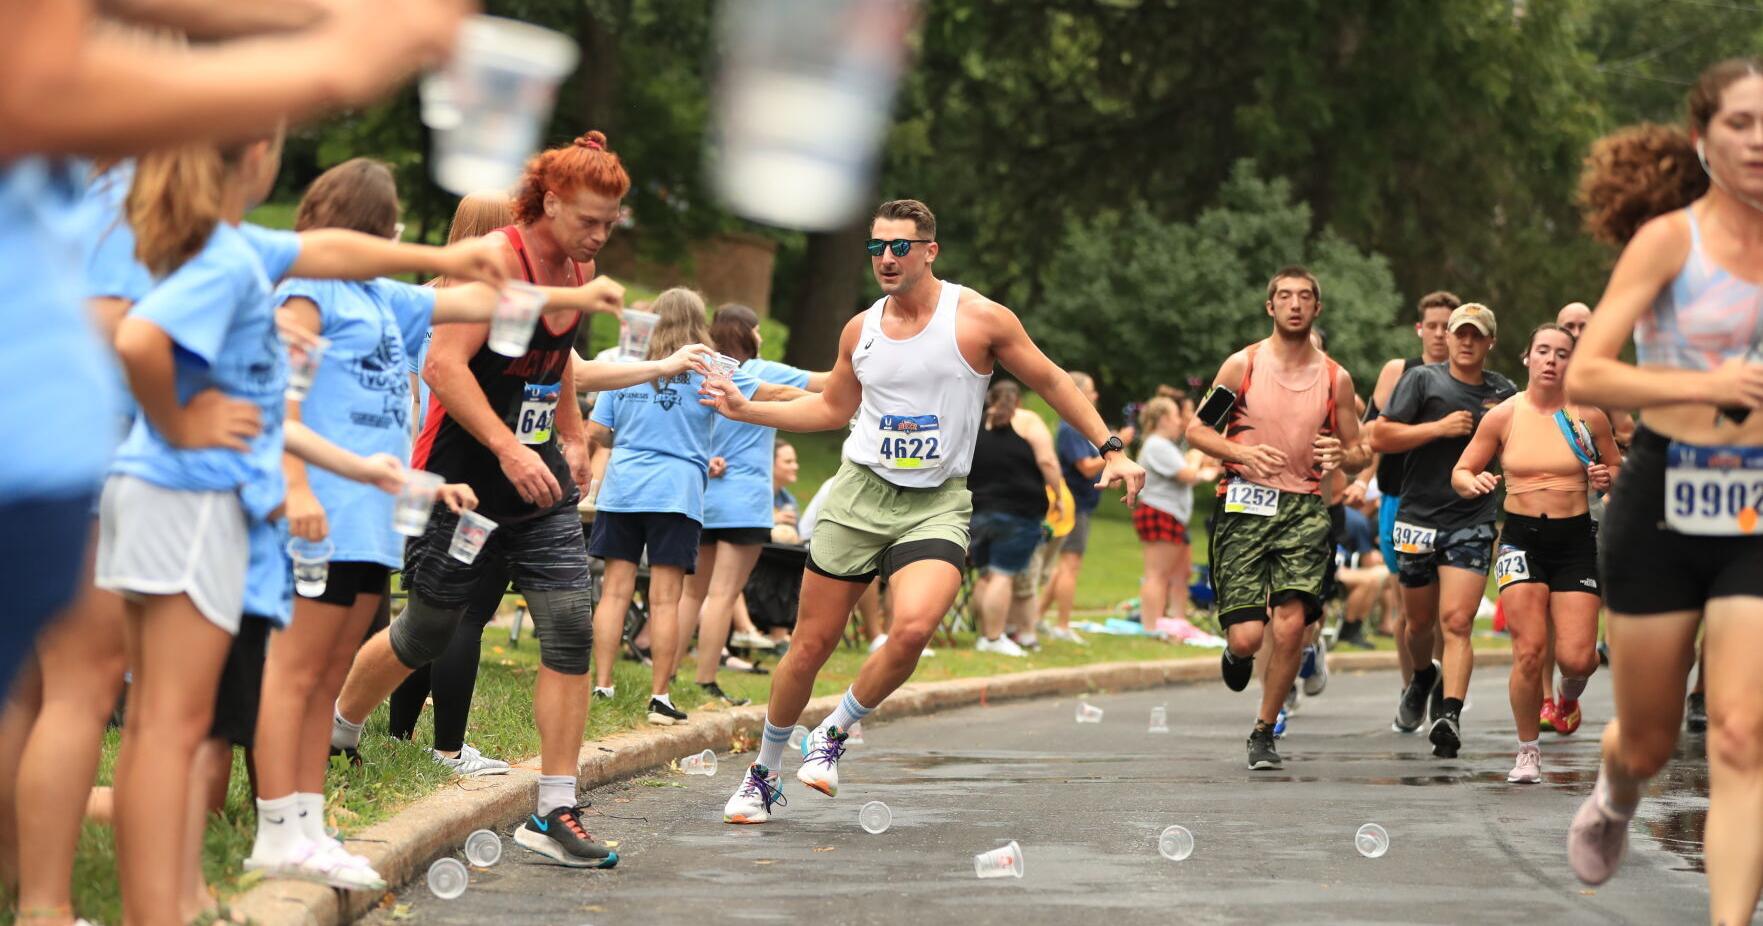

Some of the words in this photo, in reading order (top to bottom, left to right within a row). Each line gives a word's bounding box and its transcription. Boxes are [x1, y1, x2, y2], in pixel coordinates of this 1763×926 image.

[880, 437, 940, 460] 4622
[1230, 487, 1277, 507] 1252
[1395, 527, 1432, 548] 3974
[1496, 556, 1525, 577] 973
